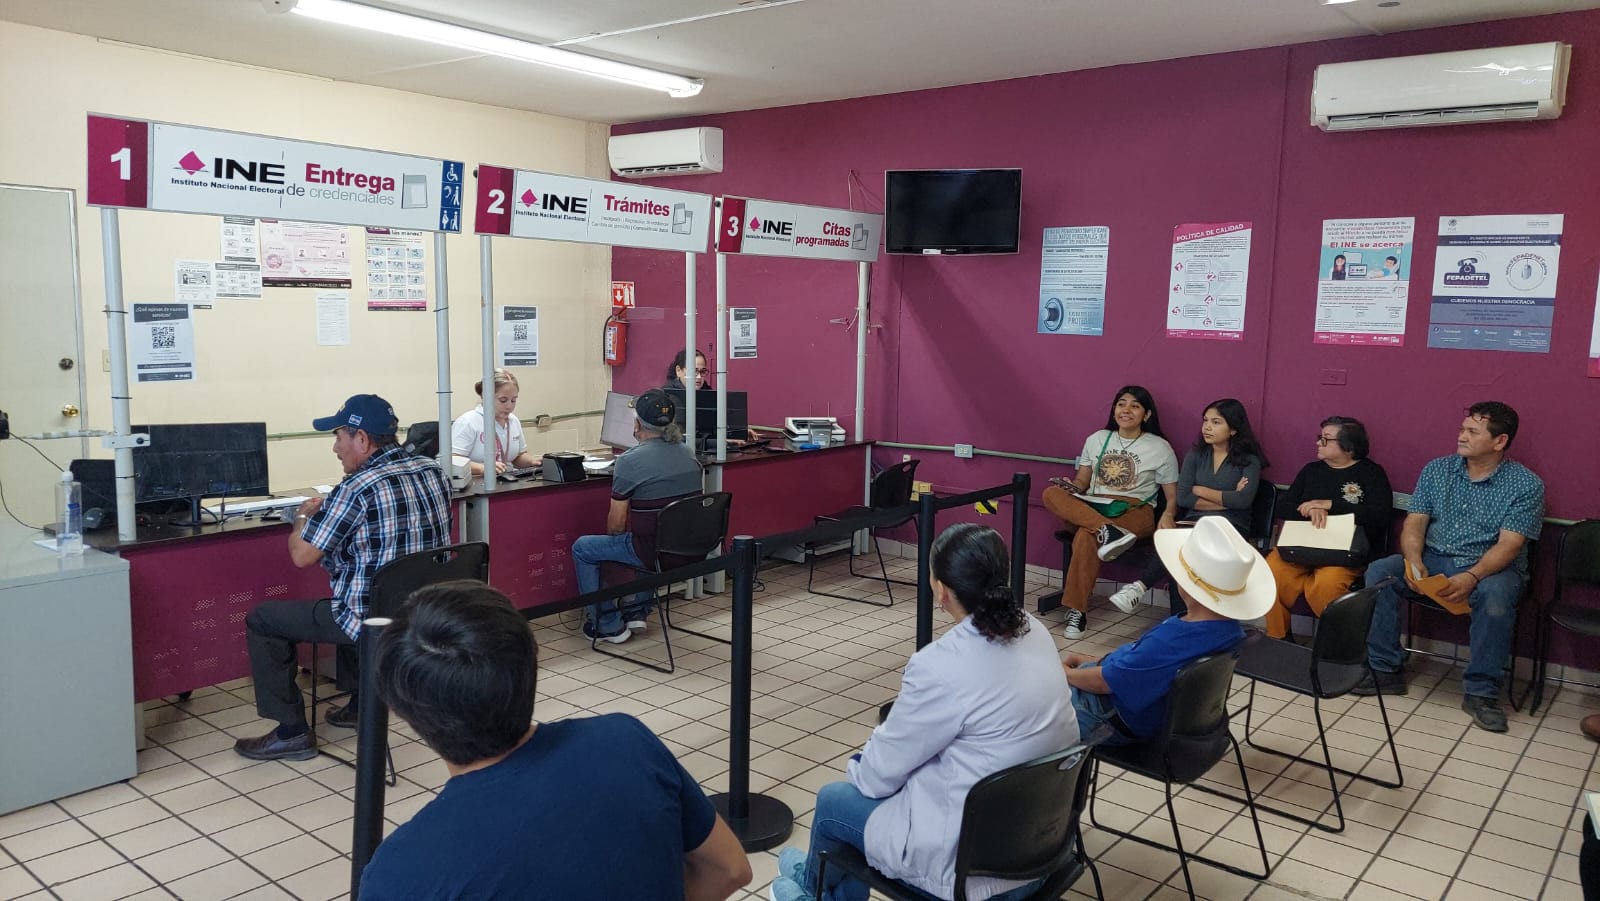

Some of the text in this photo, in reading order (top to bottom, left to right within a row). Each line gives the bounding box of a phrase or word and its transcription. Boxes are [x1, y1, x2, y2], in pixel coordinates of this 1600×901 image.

[111, 147, 131, 181] 1
[214, 157, 285, 185] INE
[171, 177, 285, 195] Instituto Nacional Electoral
[305, 163, 395, 194] Entrega
[286, 184, 395, 206] de credenciales
[487, 189, 505, 214] 2
[542, 193, 588, 214] INE
[603, 194, 670, 216] Trámites
[728, 216, 739, 237] 3
[763, 219, 793, 236] INE
[822, 221, 851, 237] Citas
[1176, 223, 1244, 242] POLÍTICA DE CALIDAD
[795, 235, 850, 248] programadas
[1330, 241, 1339, 249] El
